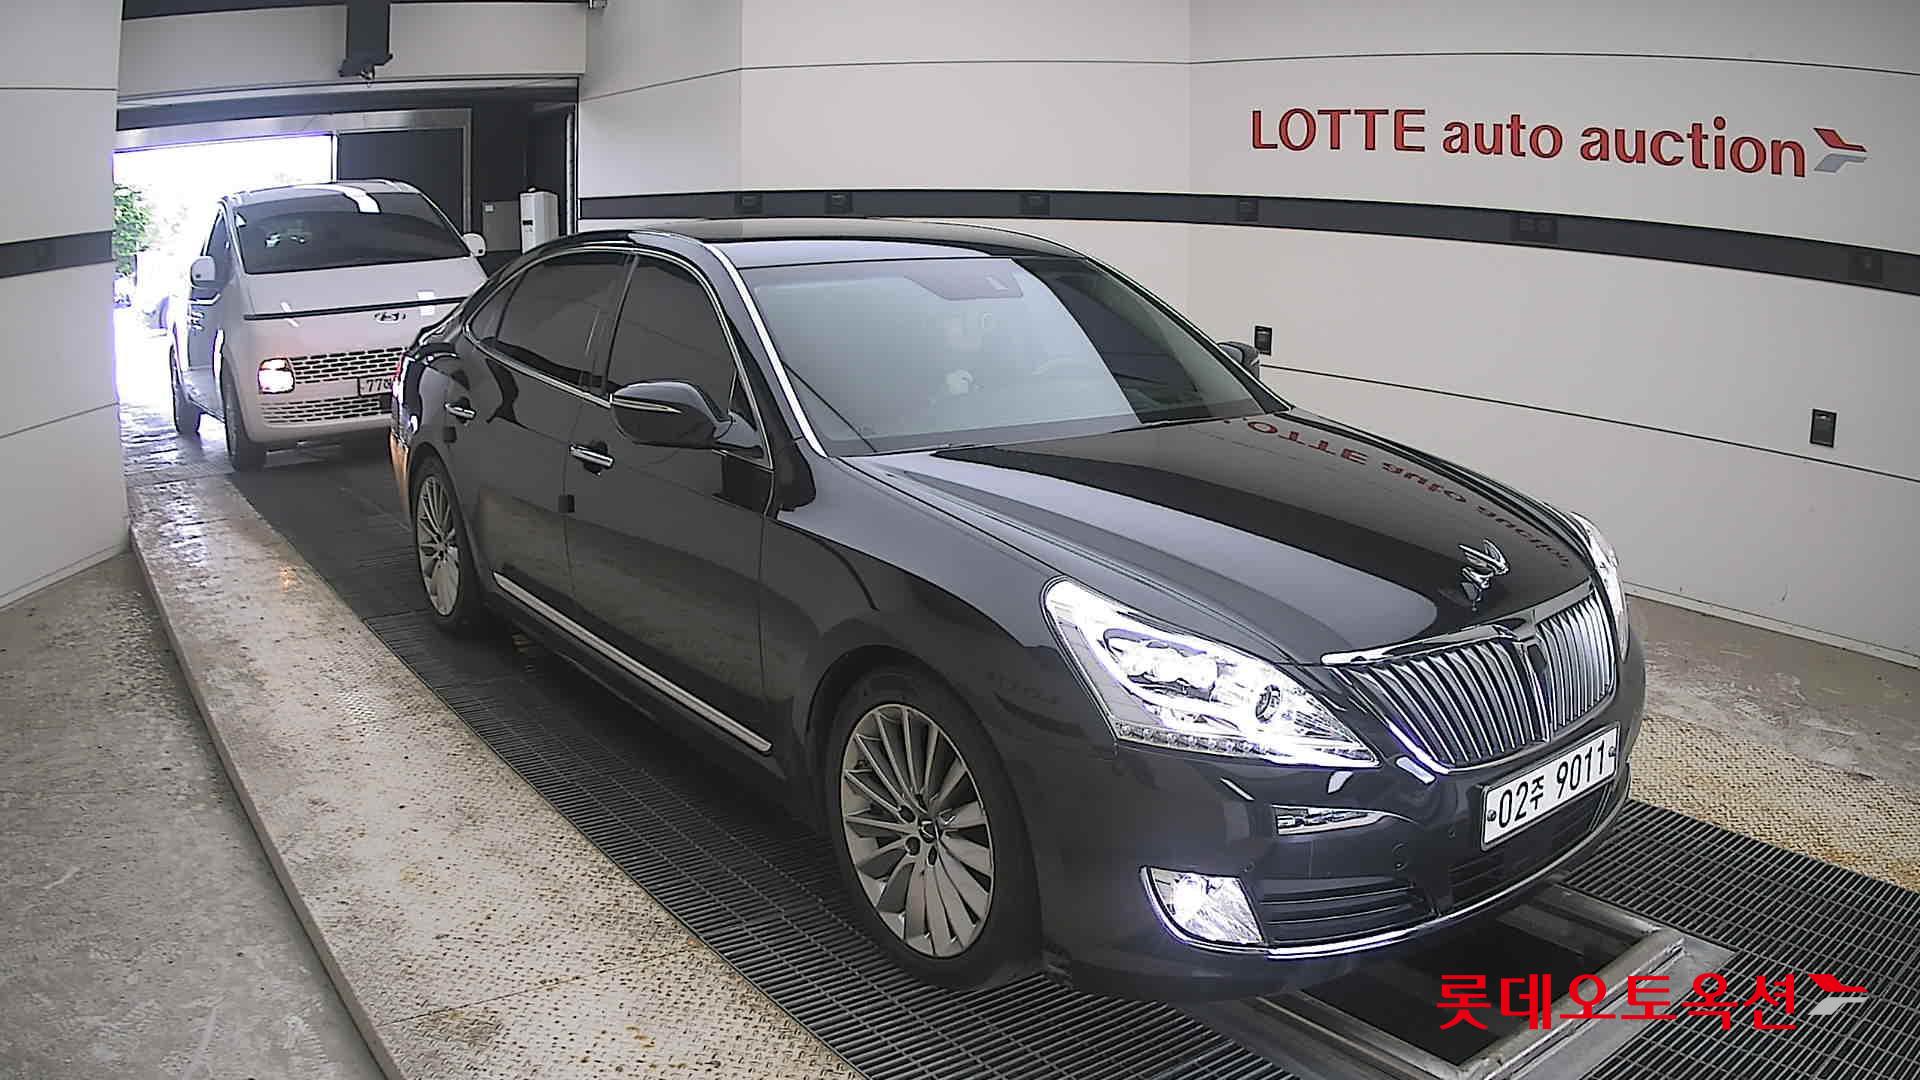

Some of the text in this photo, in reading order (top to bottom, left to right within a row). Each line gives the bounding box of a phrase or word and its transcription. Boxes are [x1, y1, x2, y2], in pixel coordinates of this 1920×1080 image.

[1252, 108, 1806, 177] LOTTE auto auction
[1498, 739, 1605, 828] 02주 9011
